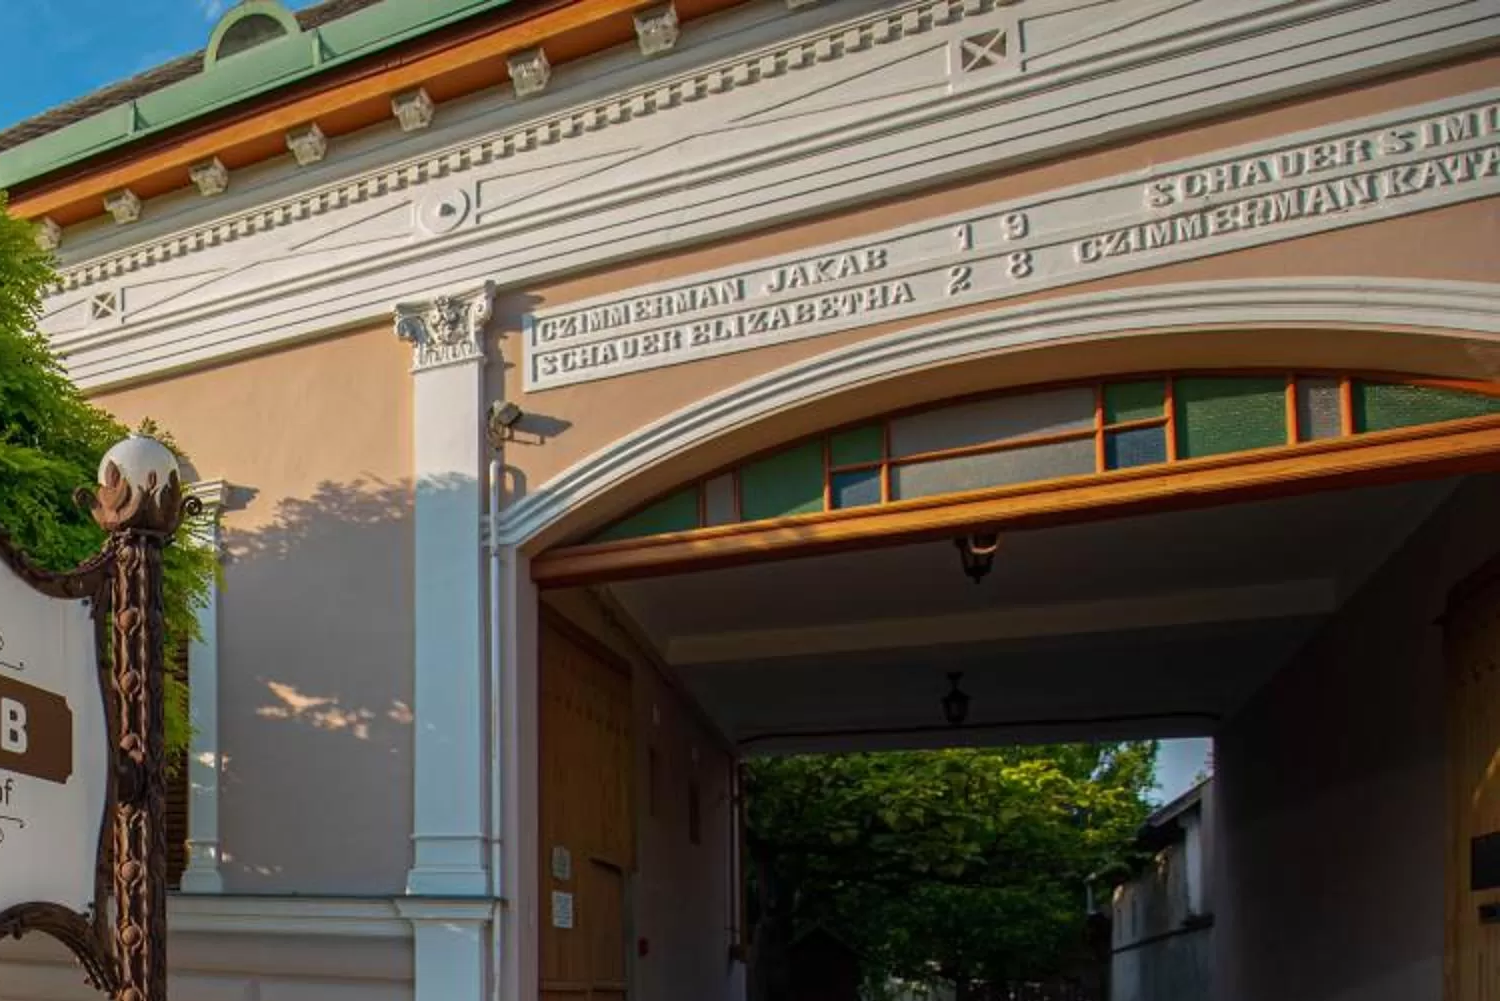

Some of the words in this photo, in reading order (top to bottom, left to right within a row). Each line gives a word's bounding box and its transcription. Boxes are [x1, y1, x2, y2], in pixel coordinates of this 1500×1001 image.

[1074, 173, 1378, 265] CZIMMERMAN
[1144, 137, 1372, 208] SCHAUER
[539, 277, 747, 344] CZIMMERMAN
[765, 247, 889, 294] JAKAB
[540, 334, 682, 376] SCHAUER
[690, 281, 917, 347] ELIZABETHA
